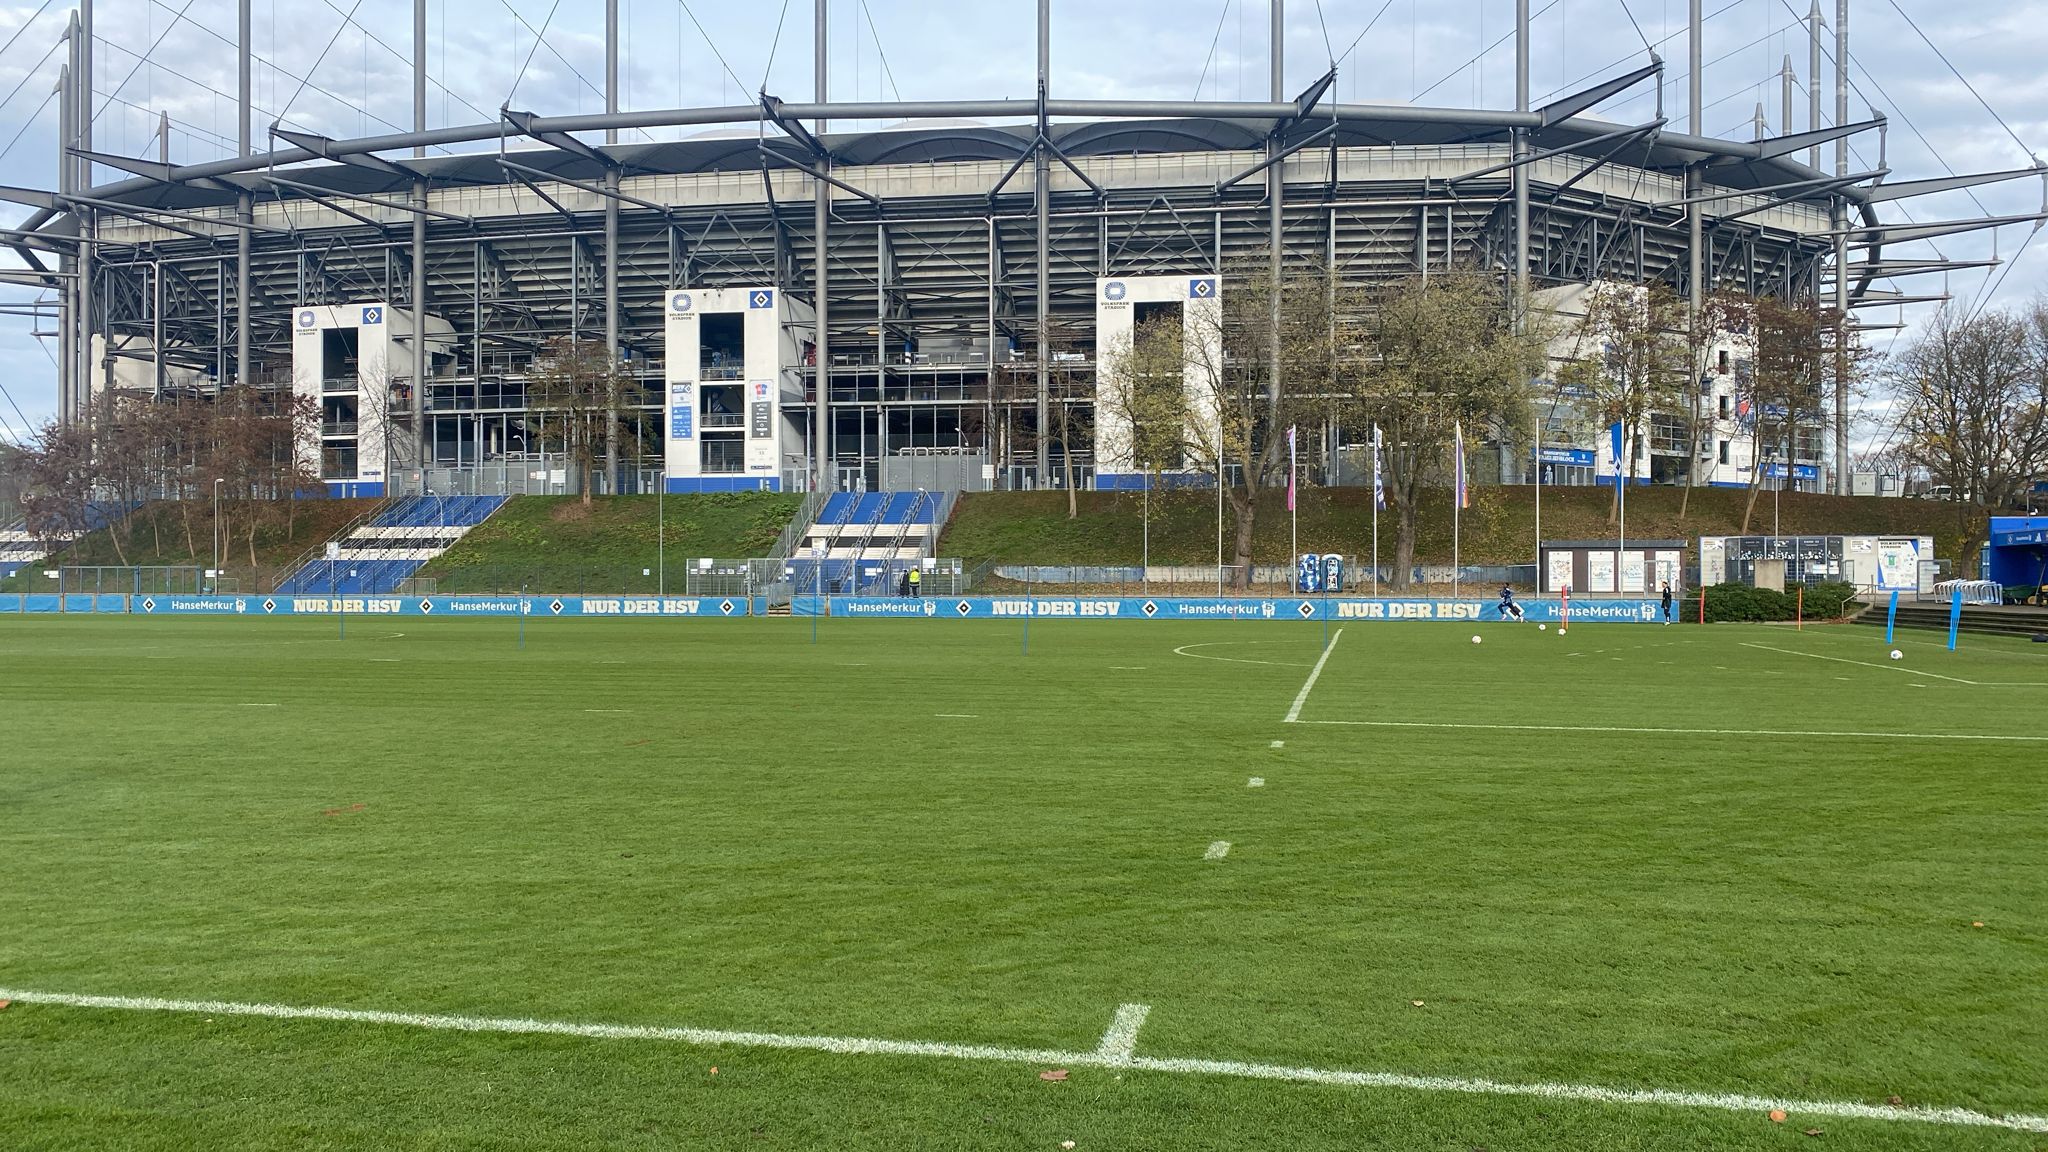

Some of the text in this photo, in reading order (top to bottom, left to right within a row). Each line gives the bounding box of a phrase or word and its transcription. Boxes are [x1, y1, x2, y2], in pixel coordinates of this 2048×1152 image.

[172, 601, 234, 610] HanseMerkur
[293, 600, 402, 613] NUR DER HSV
[450, 602, 517, 611] HanseMerkur
[583, 601, 700, 613] NUR DER HSV
[848, 603, 921, 612] HanseMerkur
[992, 601, 1121, 615] NUR DER HSV
[1180, 604, 1258, 614] HanseMerkur
[1338, 603, 1481, 617] NUR DER HSV
[1549, 606, 1638, 617] HanseMerkur
